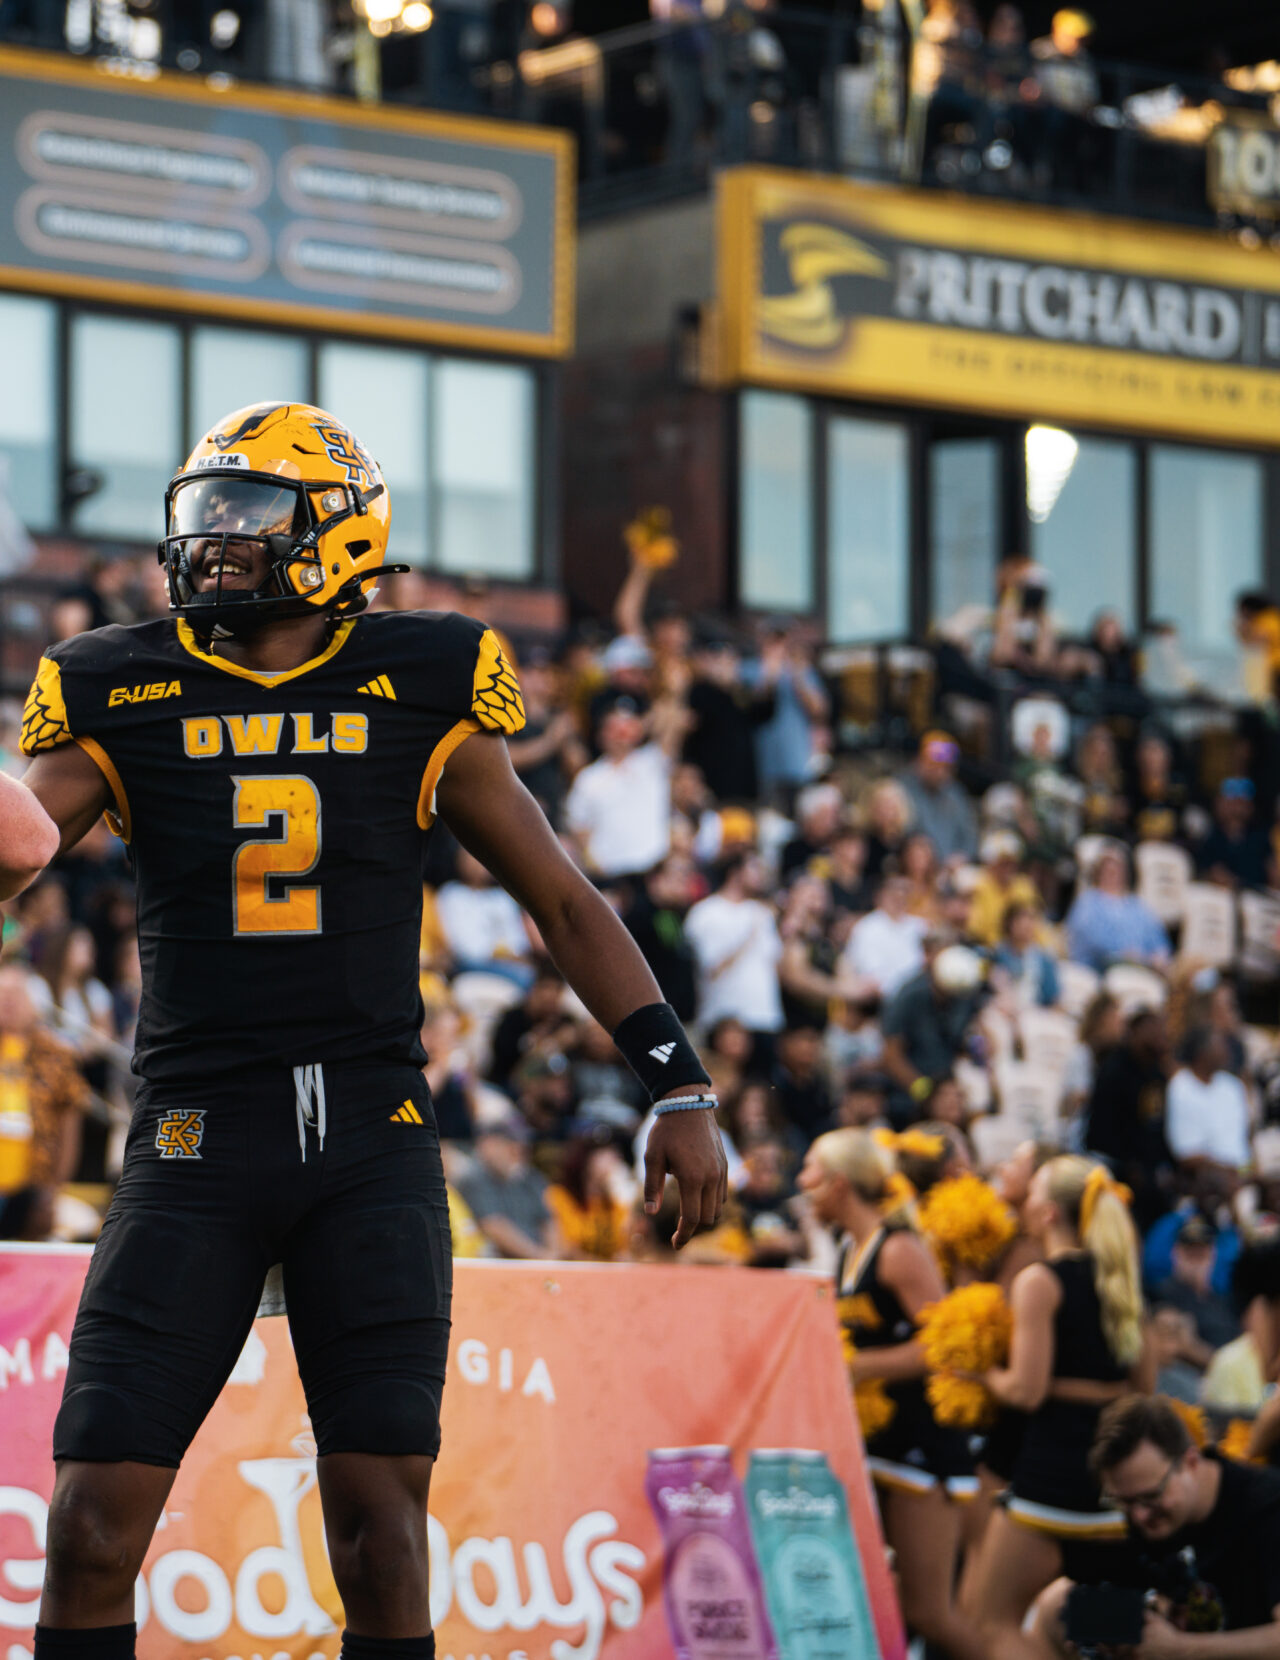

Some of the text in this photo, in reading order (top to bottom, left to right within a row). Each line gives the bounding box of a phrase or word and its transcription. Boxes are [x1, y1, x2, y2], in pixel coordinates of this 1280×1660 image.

[895, 247, 1242, 361] PRITCHARD
[181, 713, 369, 758] OWLS
[231, 774, 322, 936] 2
